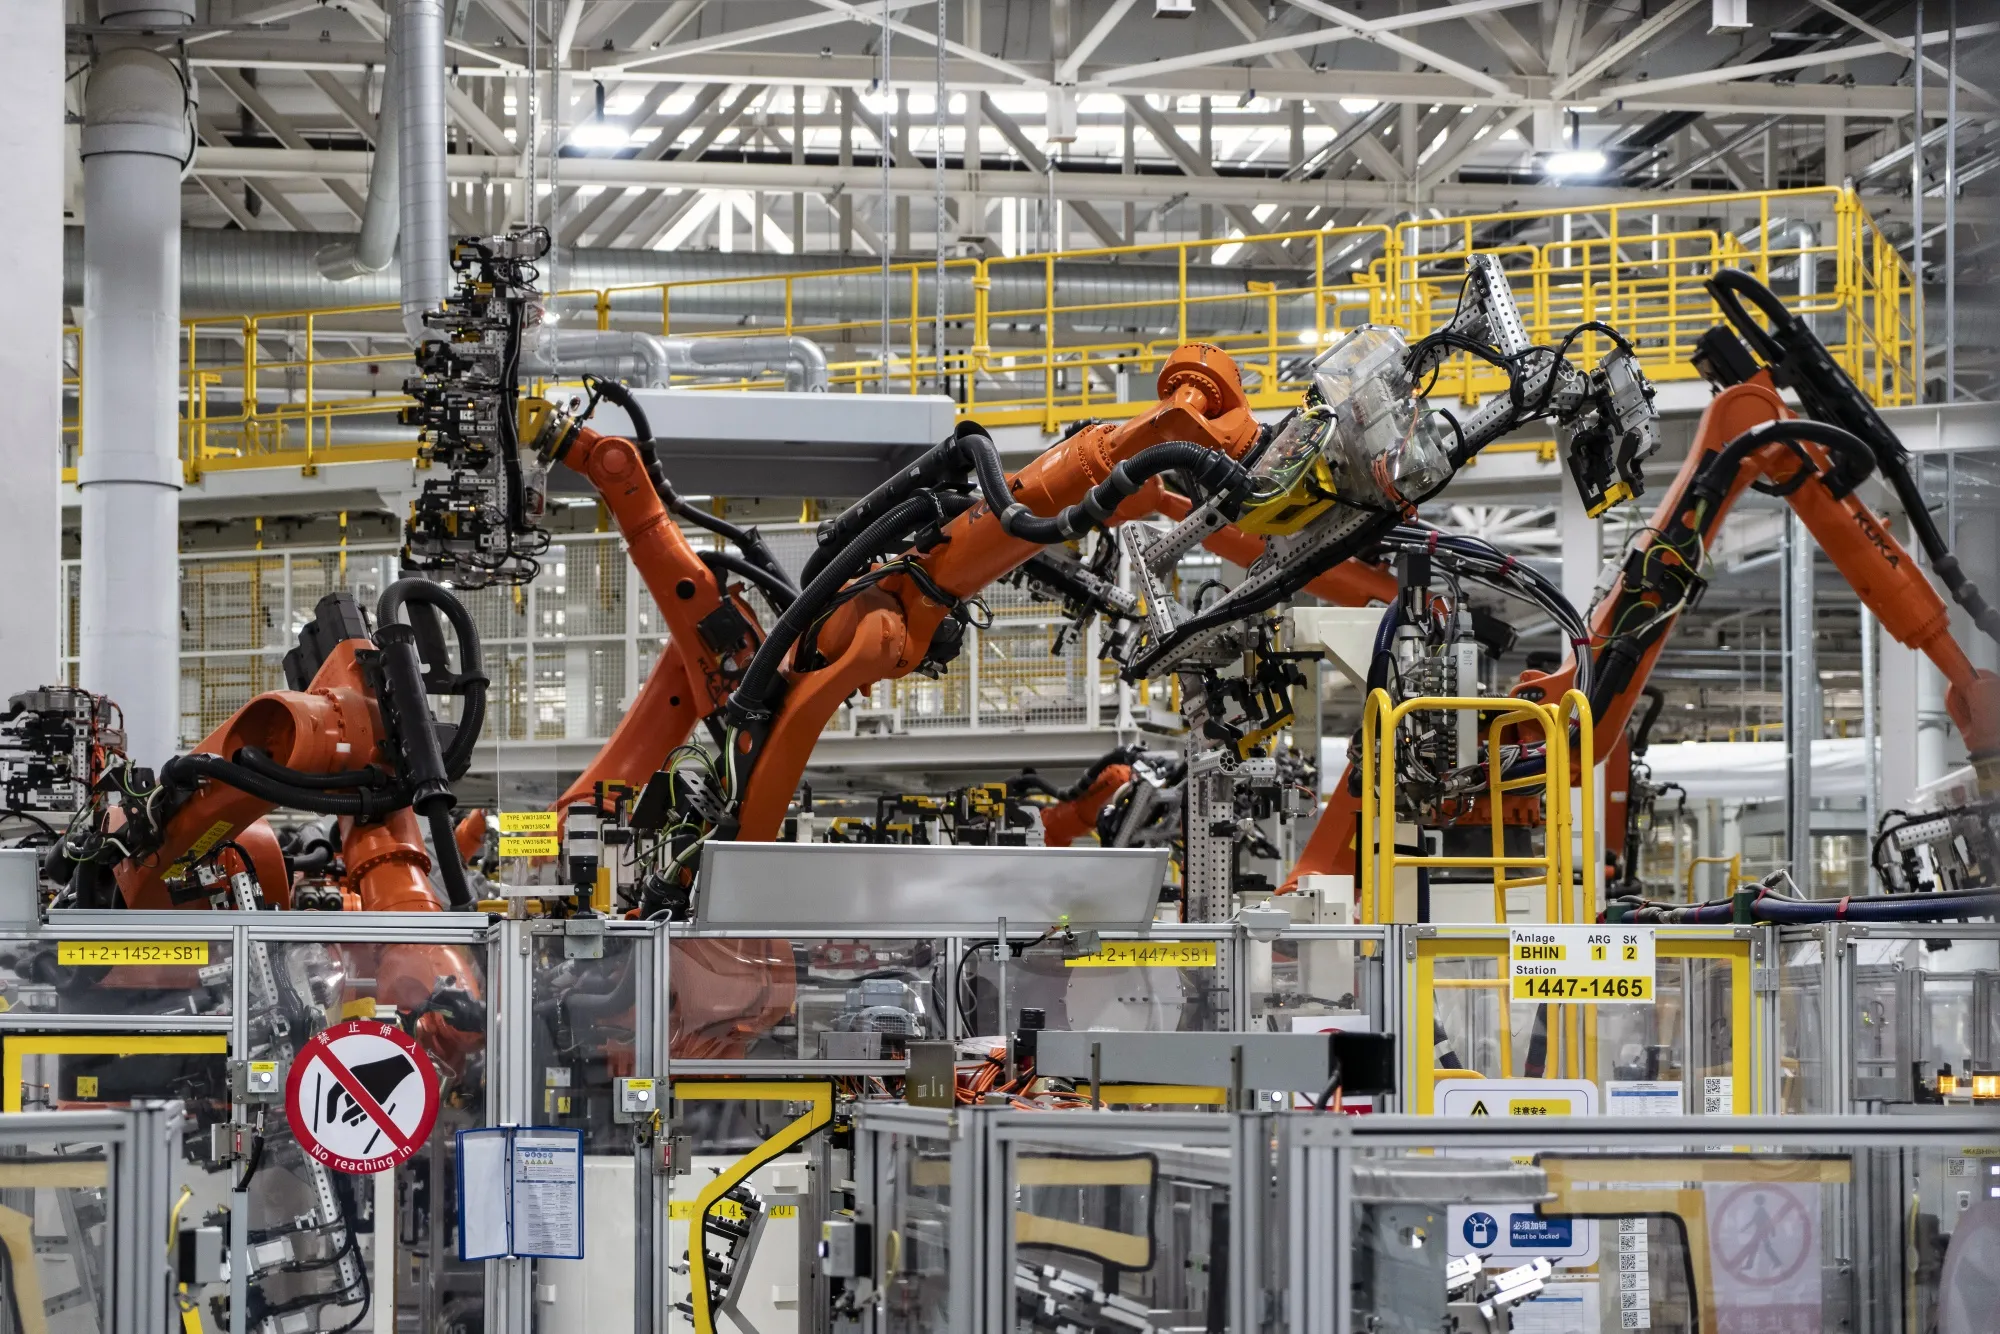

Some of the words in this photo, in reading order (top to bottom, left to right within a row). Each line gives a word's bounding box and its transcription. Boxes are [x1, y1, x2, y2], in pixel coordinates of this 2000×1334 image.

[1852, 511, 1899, 570] KUKA
[1516, 934, 1555, 944] Anlage
[1587, 935, 1611, 944] ARG
[1623, 935, 1638, 944] SK
[66, 946, 201, 960] +1+2+1452+SB1
[1075, 947, 1208, 962] 1+2+1447+SB1
[1521, 946, 1559, 959] BHIN
[1595, 947, 1602, 959] 1
[1626, 947, 1635, 959] 2
[1516, 965, 1557, 975] Station
[1525, 978, 1643, 997] 1447-1465
[1513, 1107, 1547, 1116] 注意安全
[311, 1143, 329, 1161] No
[334, 1155, 395, 1171] reaching
[397, 1145, 413, 1158] in
